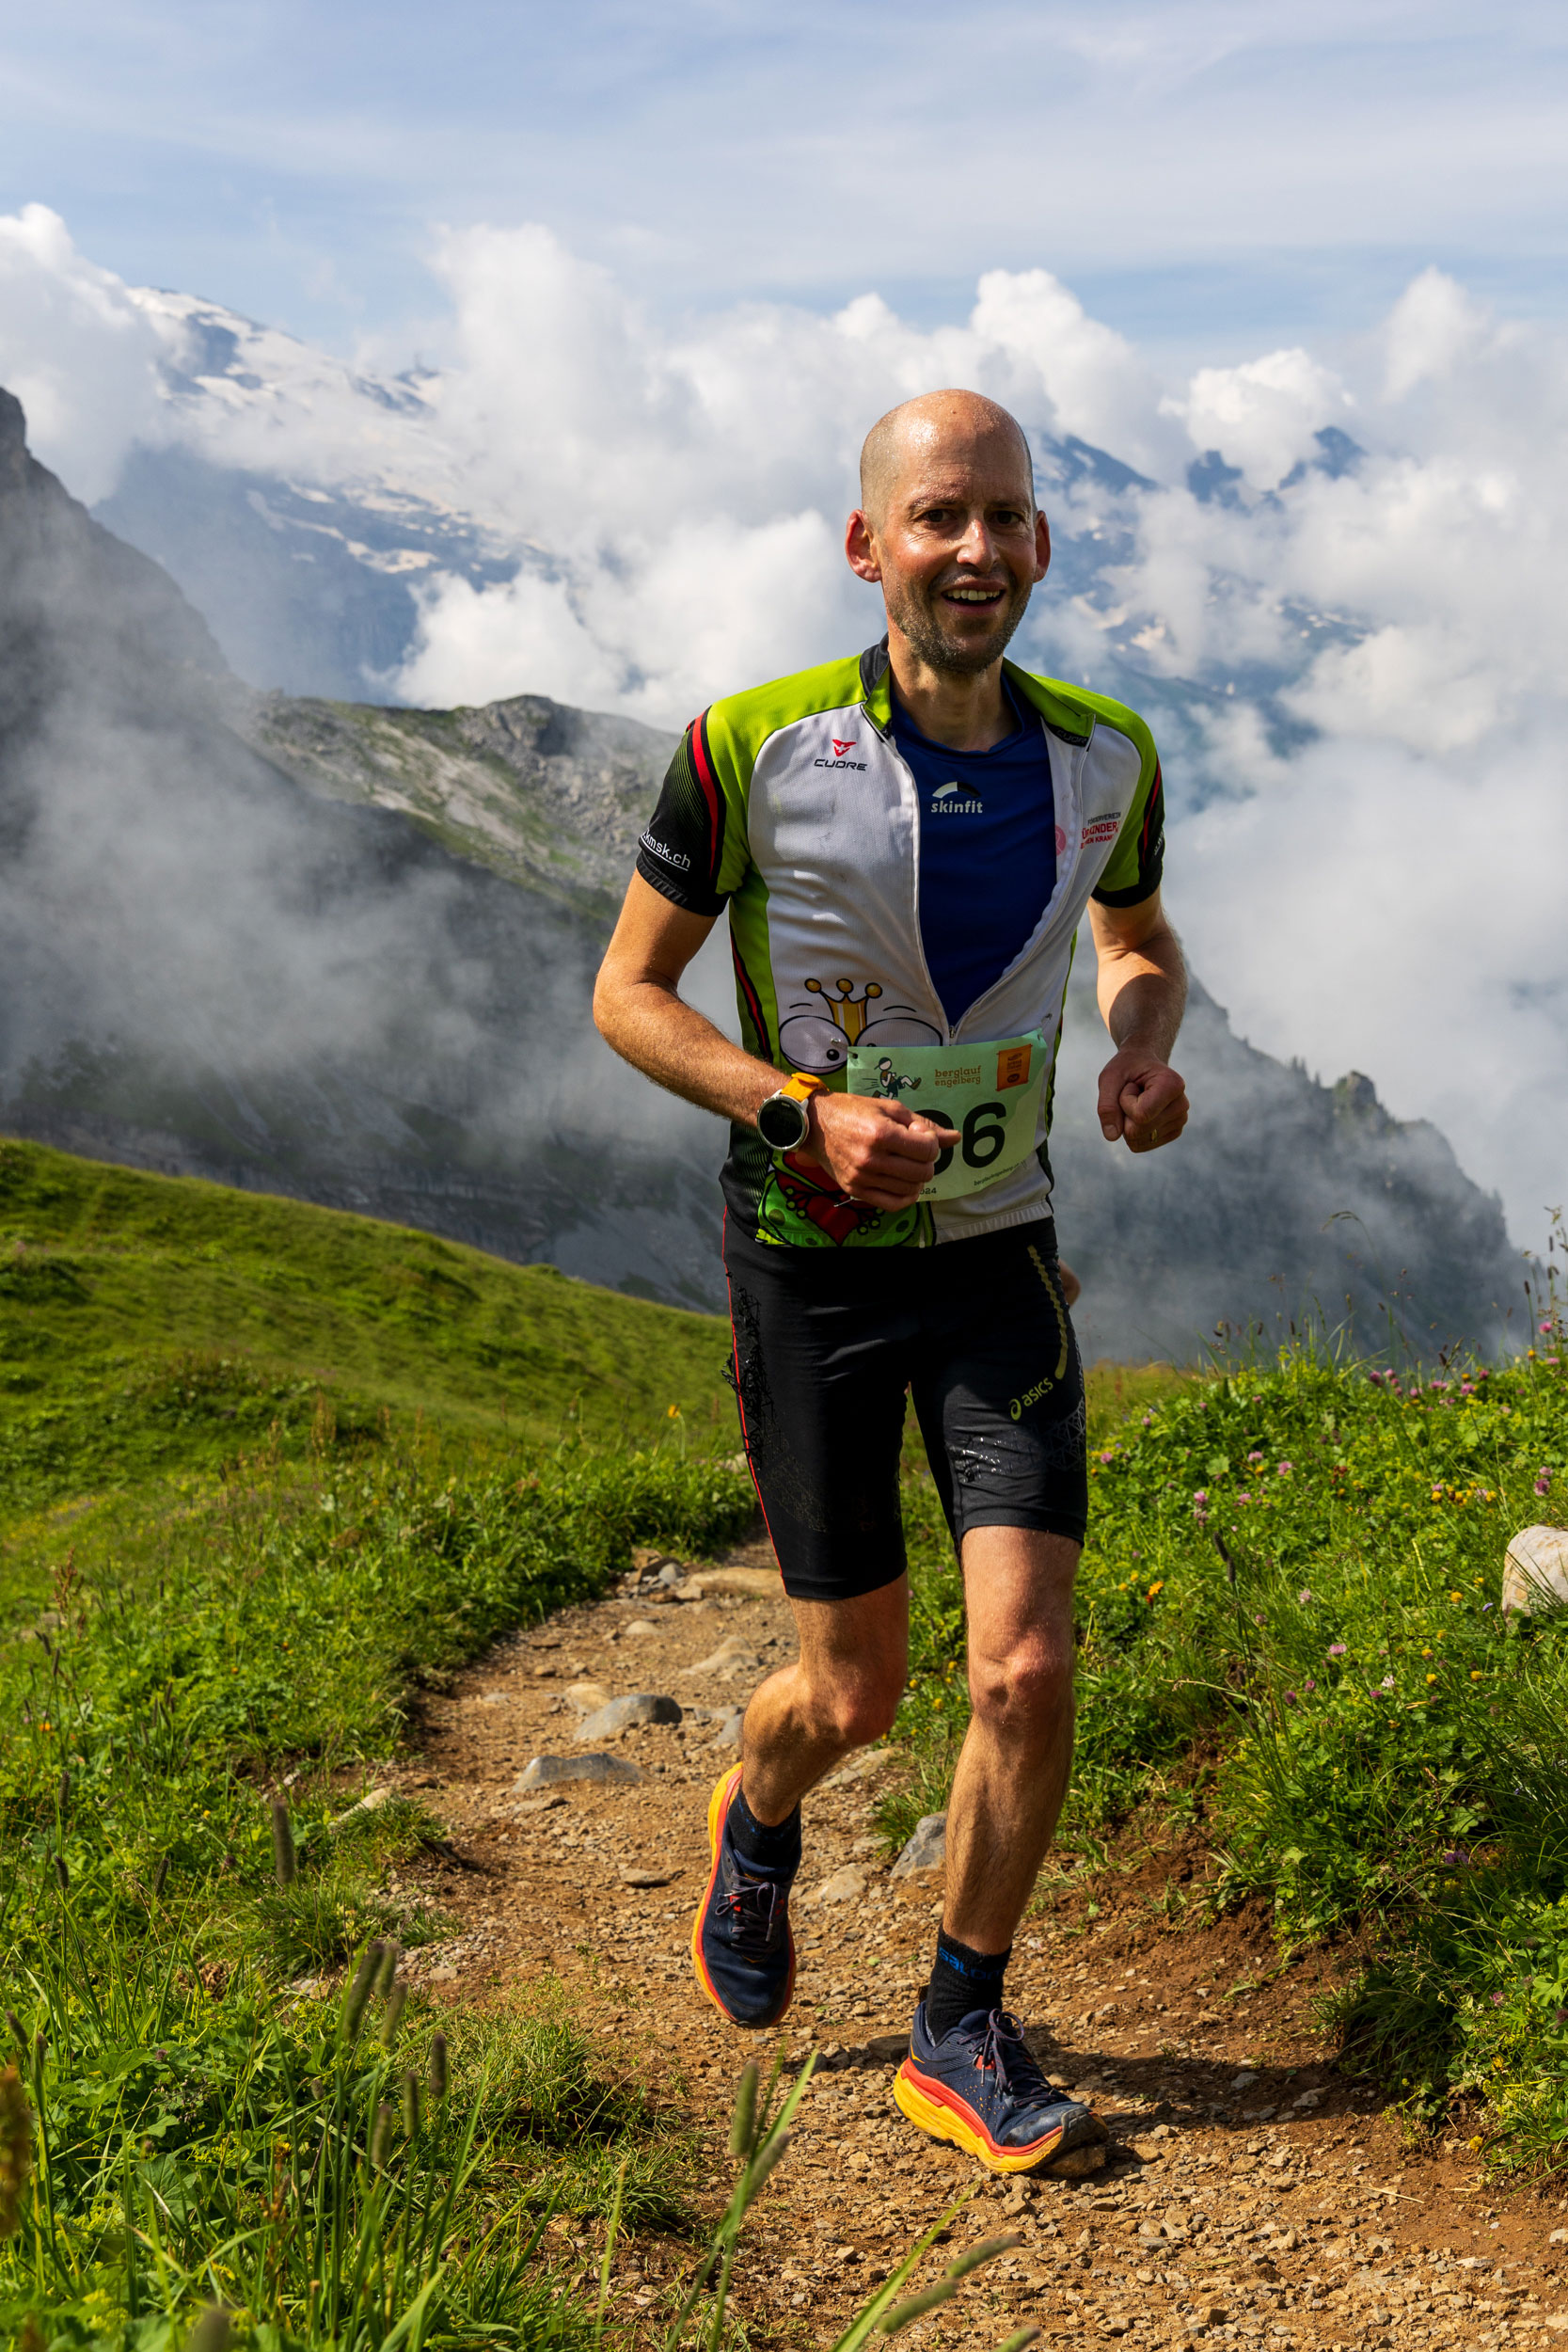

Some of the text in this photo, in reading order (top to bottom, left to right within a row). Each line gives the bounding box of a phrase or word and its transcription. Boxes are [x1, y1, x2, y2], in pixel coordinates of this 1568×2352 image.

[814, 758, 867, 771] CUORE
[930, 801, 983, 814] skinfit
[934, 1064, 982, 1079] berglauf
[934, 1075, 981, 1089] engelberg
[1022, 1377, 1053, 1407] asics
